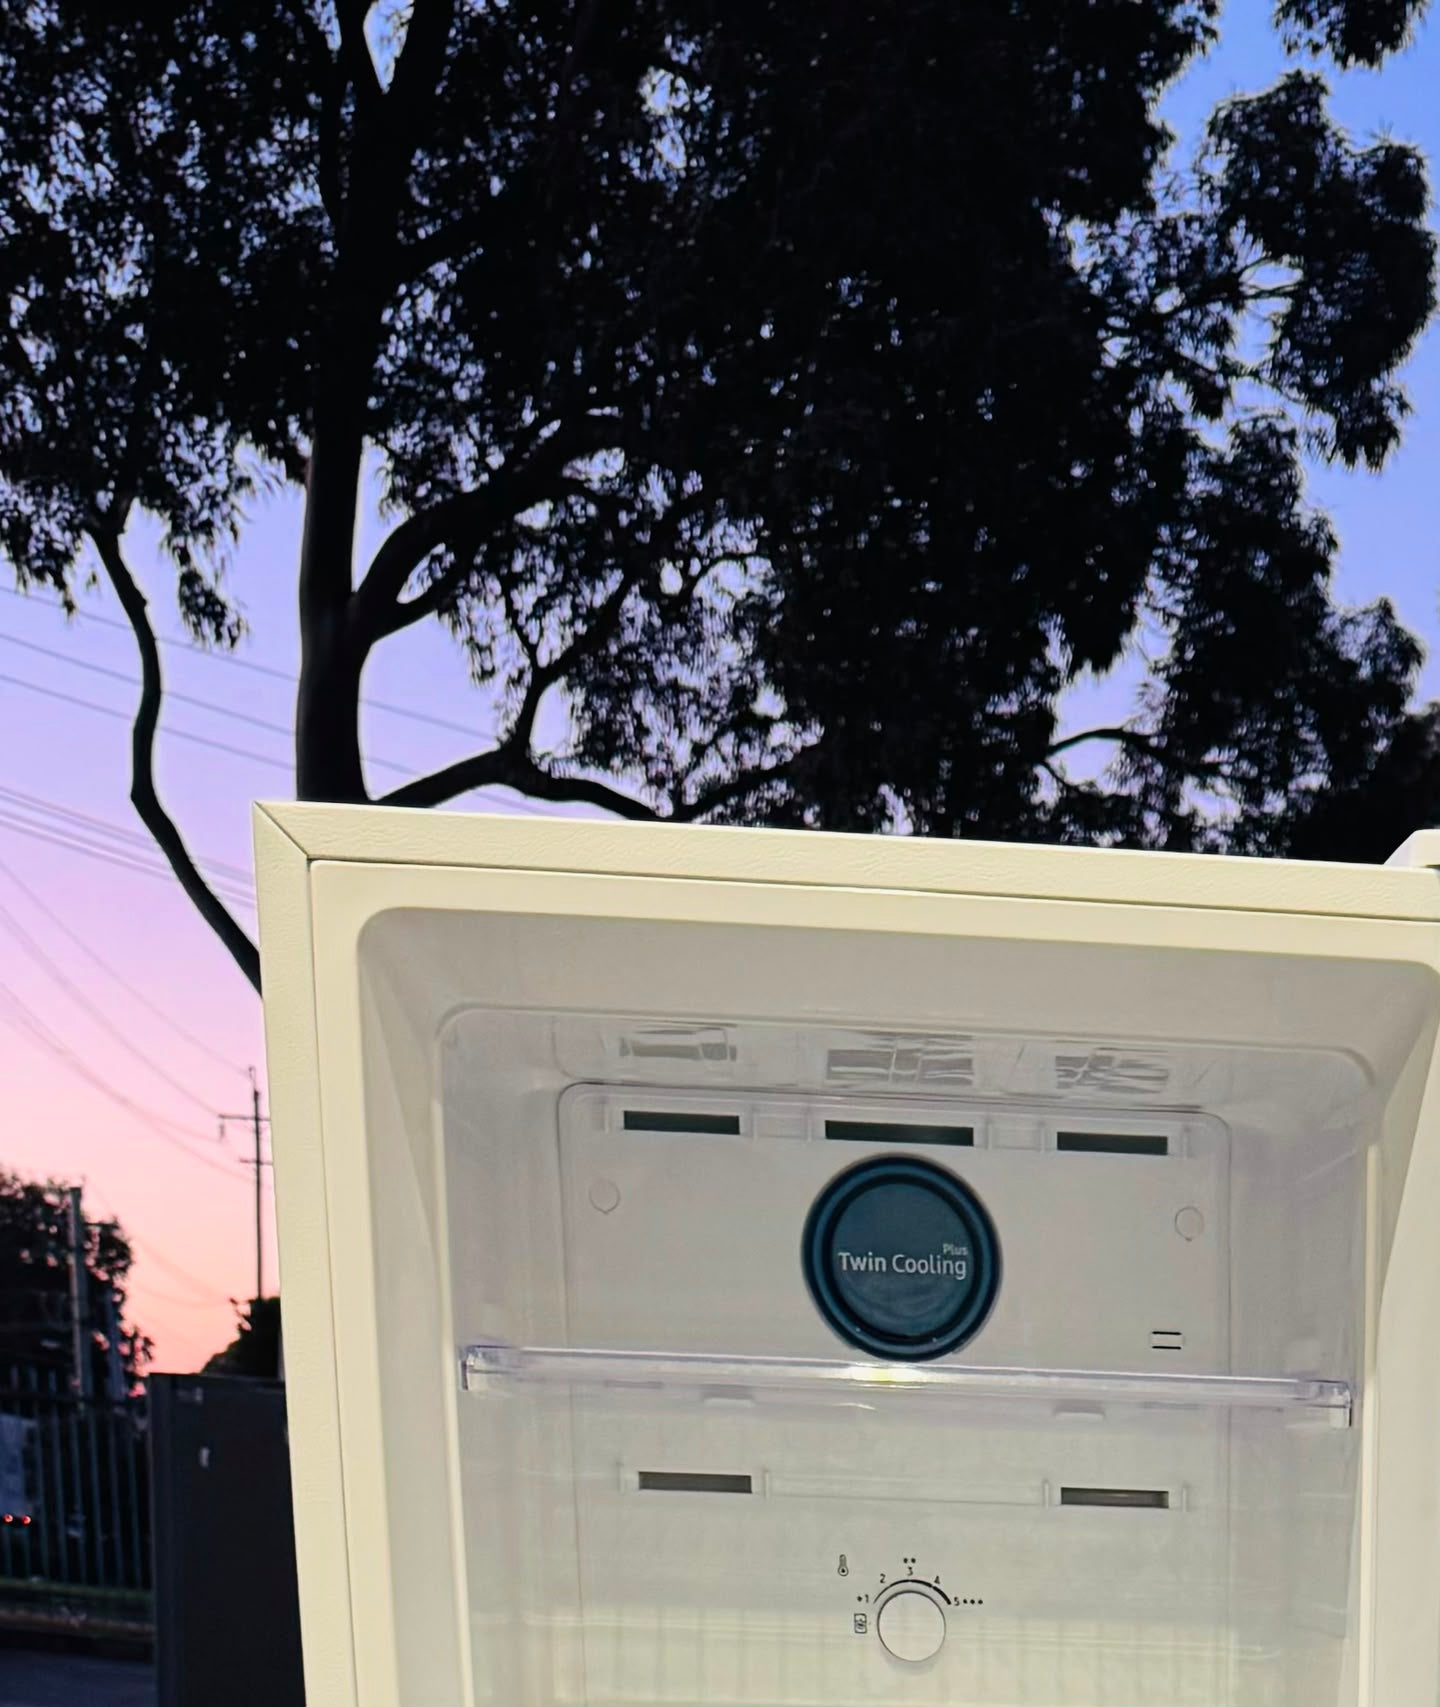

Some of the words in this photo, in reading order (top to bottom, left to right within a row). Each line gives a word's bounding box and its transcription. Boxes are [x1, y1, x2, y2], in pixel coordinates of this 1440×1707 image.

[943, 1243, 968, 1256] Plus
[838, 1251, 887, 1272] Twin
[892, 1254, 967, 1280] Cooling
[879, 1573, 886, 1584] 2
[907, 1566, 914, 1576] 3
[934, 1575, 941, 1585] 4
[953, 1597, 960, 1607] 5
